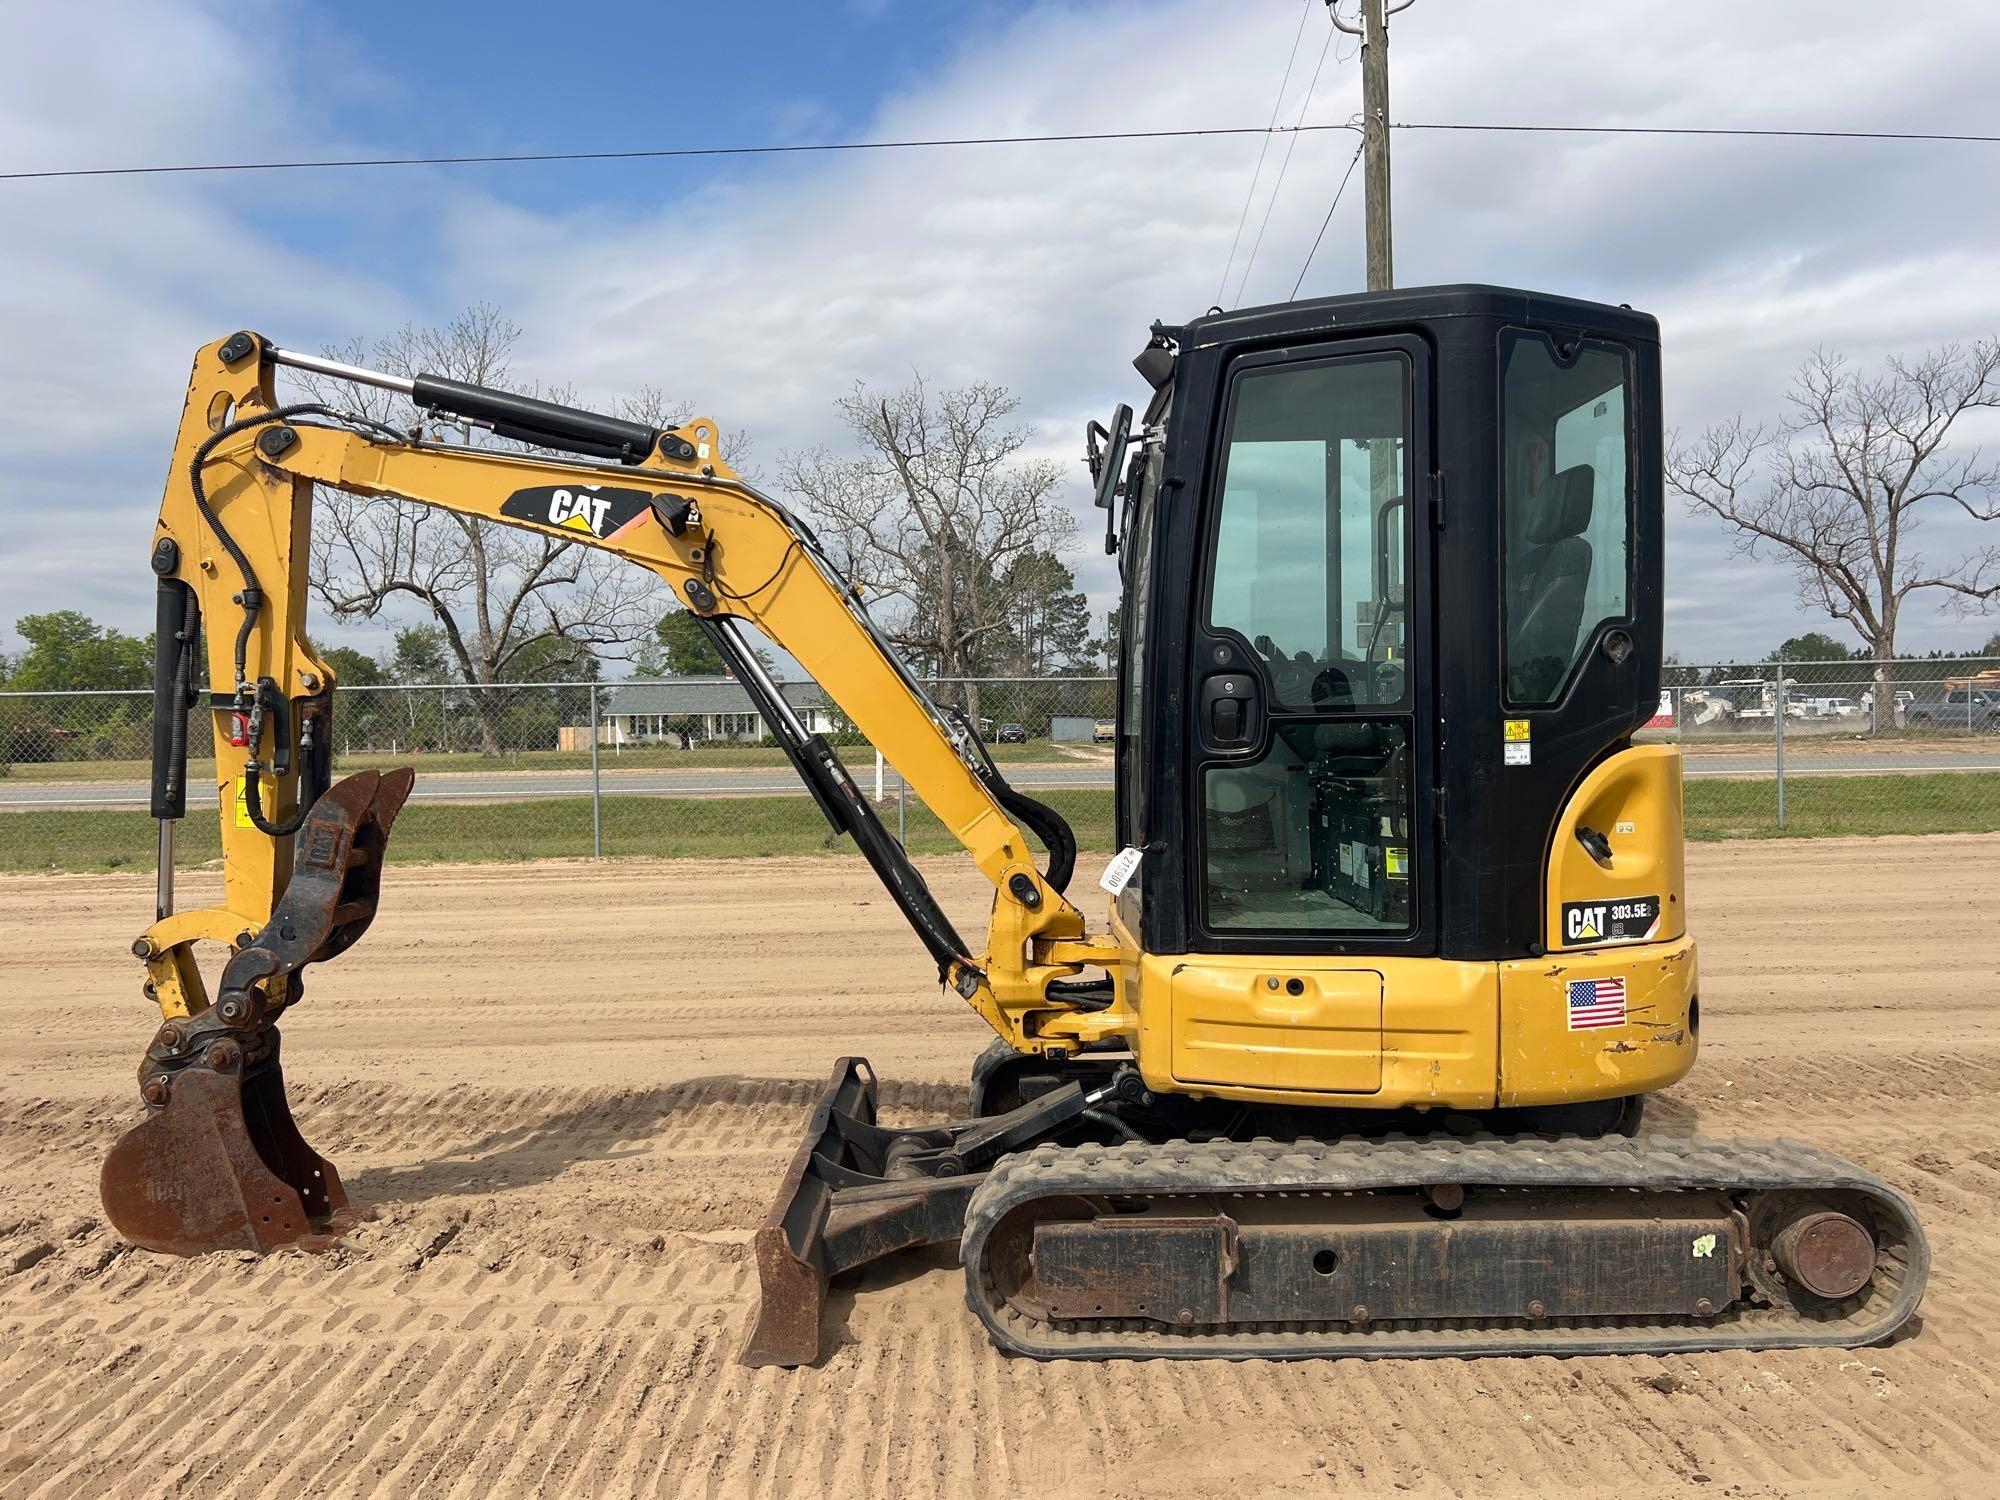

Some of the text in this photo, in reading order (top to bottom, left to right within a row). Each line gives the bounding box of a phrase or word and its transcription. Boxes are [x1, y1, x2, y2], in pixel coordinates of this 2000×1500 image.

[548, 489, 611, 539] CAT
[1568, 906, 1606, 939] CAT
[1611, 922, 1625, 936] CR
